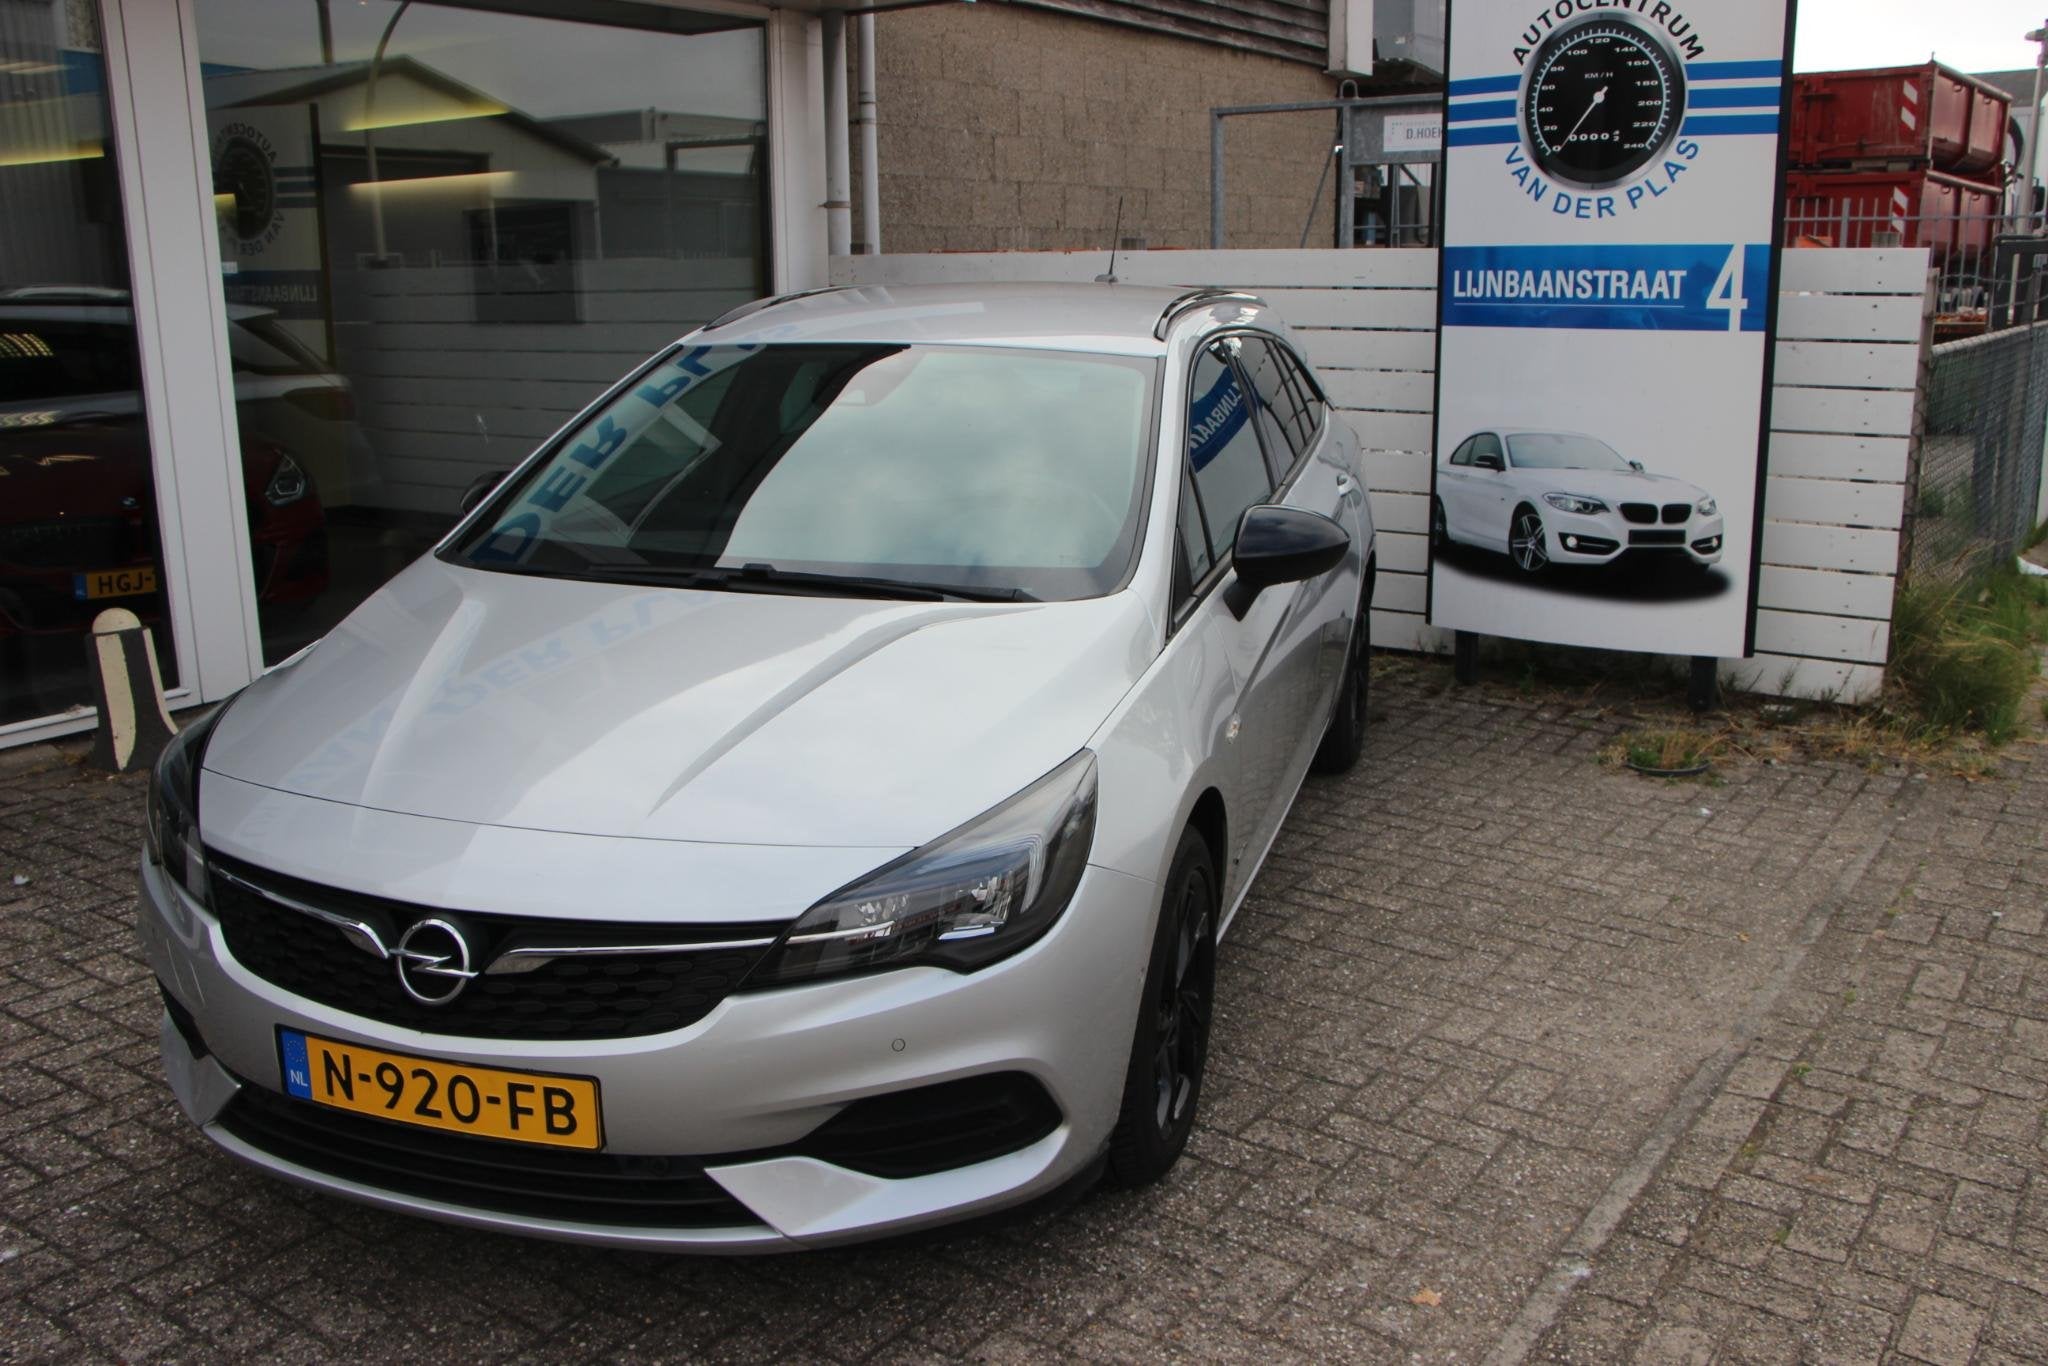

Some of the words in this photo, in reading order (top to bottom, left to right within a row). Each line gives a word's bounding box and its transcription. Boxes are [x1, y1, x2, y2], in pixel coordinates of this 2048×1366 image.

[1505, 146, 1548, 202] VAN
[1553, 192, 1616, 219] DER
[1626, 139, 1700, 210] PLAS
[1453, 269, 1687, 300] LIJNBAANSTRAAT
[1706, 244, 1748, 332] 4
[290, 1069, 309, 1087] NL
[322, 1049, 578, 1136] N-920-FB
